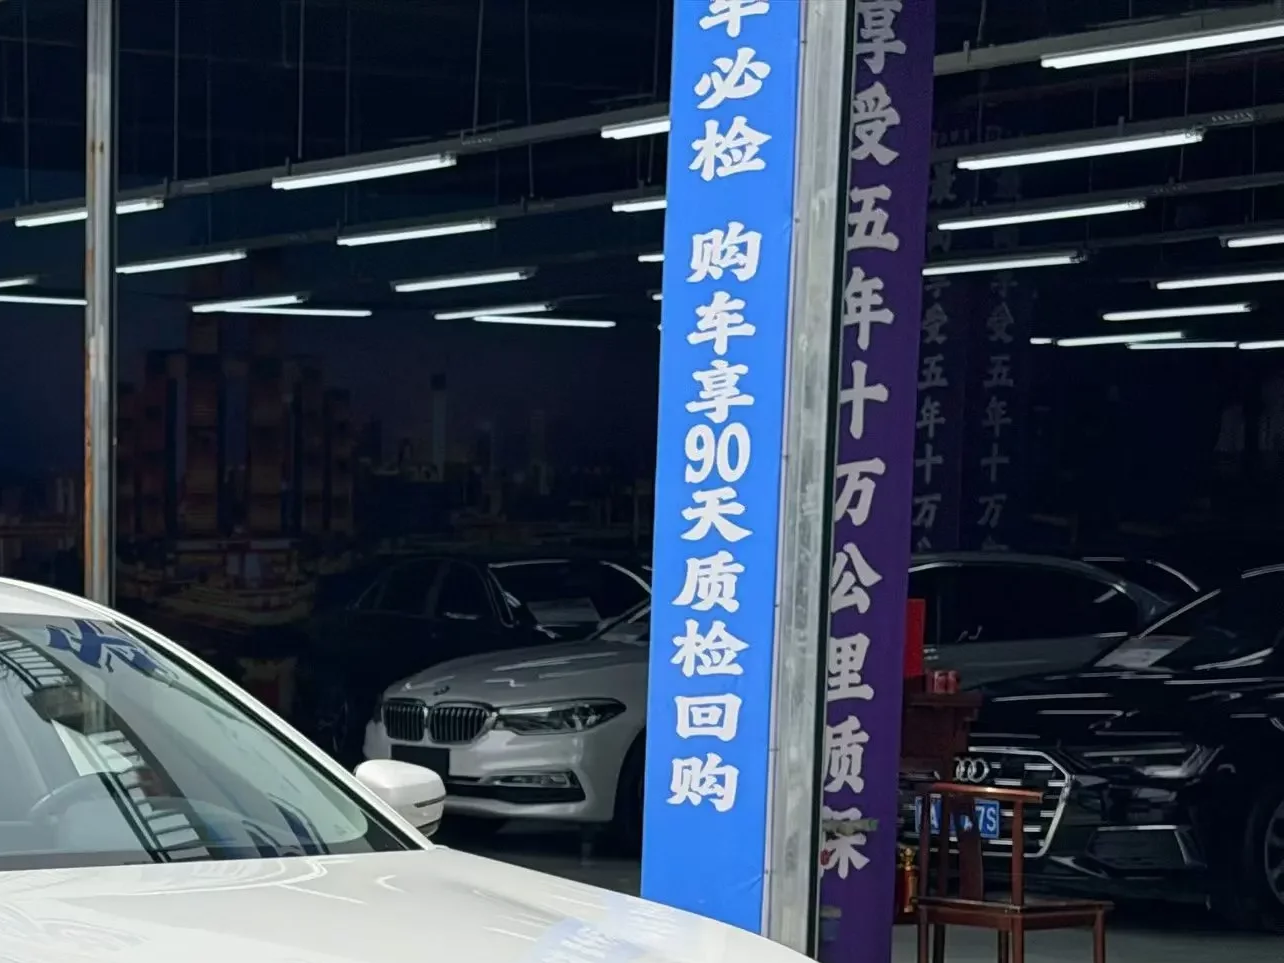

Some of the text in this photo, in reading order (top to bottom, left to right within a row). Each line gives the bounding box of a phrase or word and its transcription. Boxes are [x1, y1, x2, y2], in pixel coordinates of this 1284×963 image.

[667, 221, 762, 812] 购车享90天质检回购
